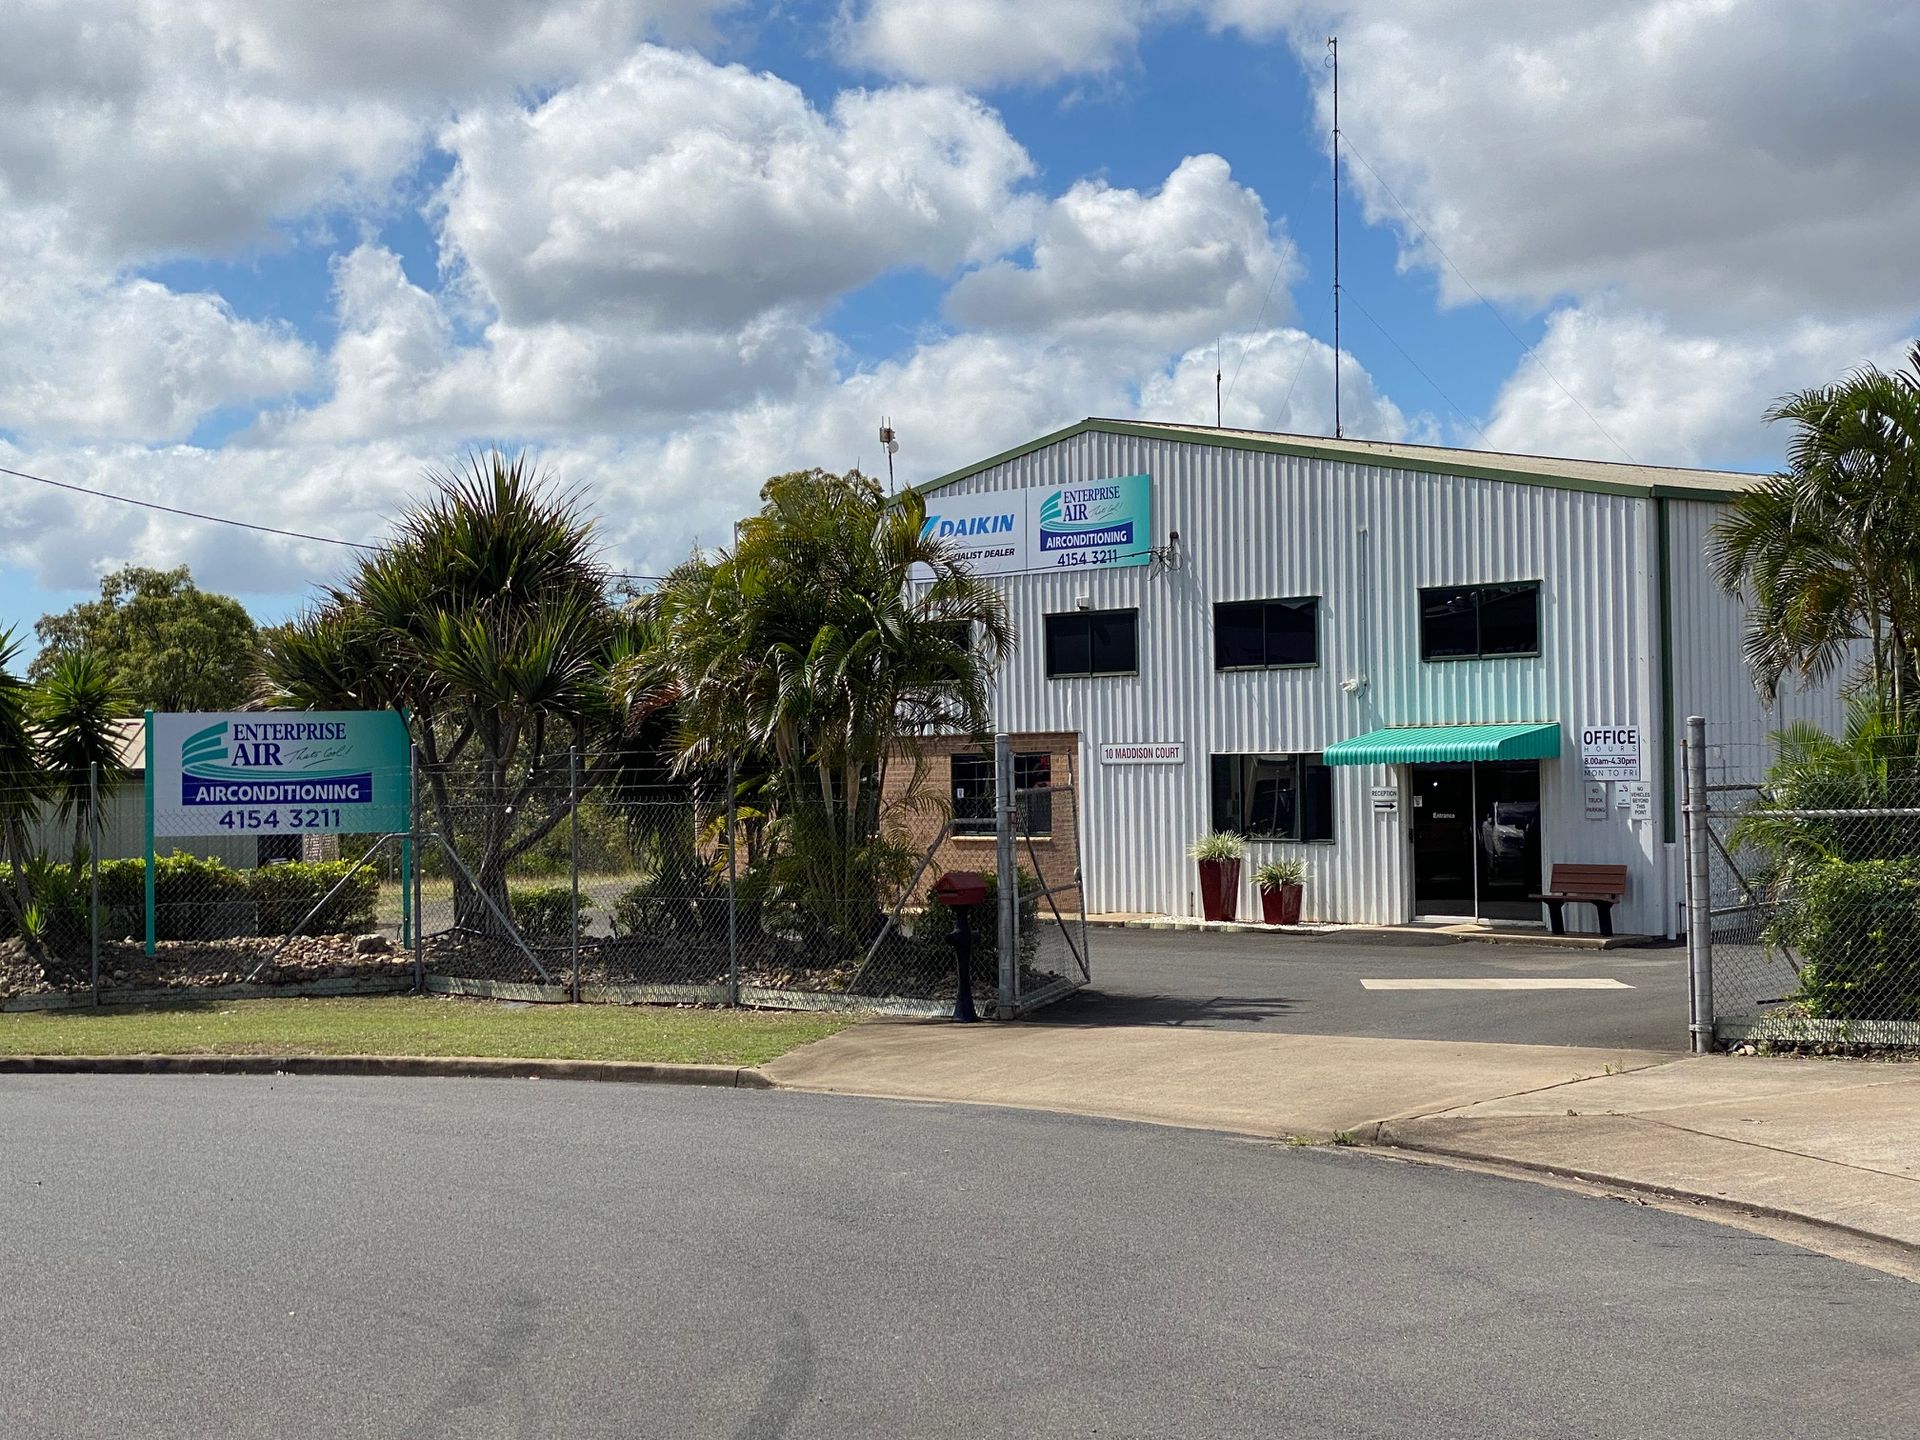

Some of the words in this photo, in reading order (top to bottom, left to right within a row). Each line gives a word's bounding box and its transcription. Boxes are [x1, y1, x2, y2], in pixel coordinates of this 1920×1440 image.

[1064, 486, 1120, 504] ENTERPRISE
[1063, 503, 1088, 522] AIR
[939, 514, 1015, 537] DAIKIN
[1046, 530, 1127, 549] AIRCONDITIONING
[984, 548, 1015, 558] DEALER
[1057, 551, 1087, 567] 4154
[1091, 549, 1118, 564] 3211
[233, 722, 346, 741] ENTERPRISE
[1584, 730, 1636, 745] OFFICE
[231, 743, 283, 766] AIR
[1105, 748, 1114, 759] 10
[1115, 747, 1153, 759] MADDISON
[1155, 747, 1180, 758] COURT
[1584, 769, 1604, 777] MON
[195, 784, 359, 802] AIRCONDITIONING
[219, 810, 280, 829] 4154
[289, 809, 341, 827] 3211
